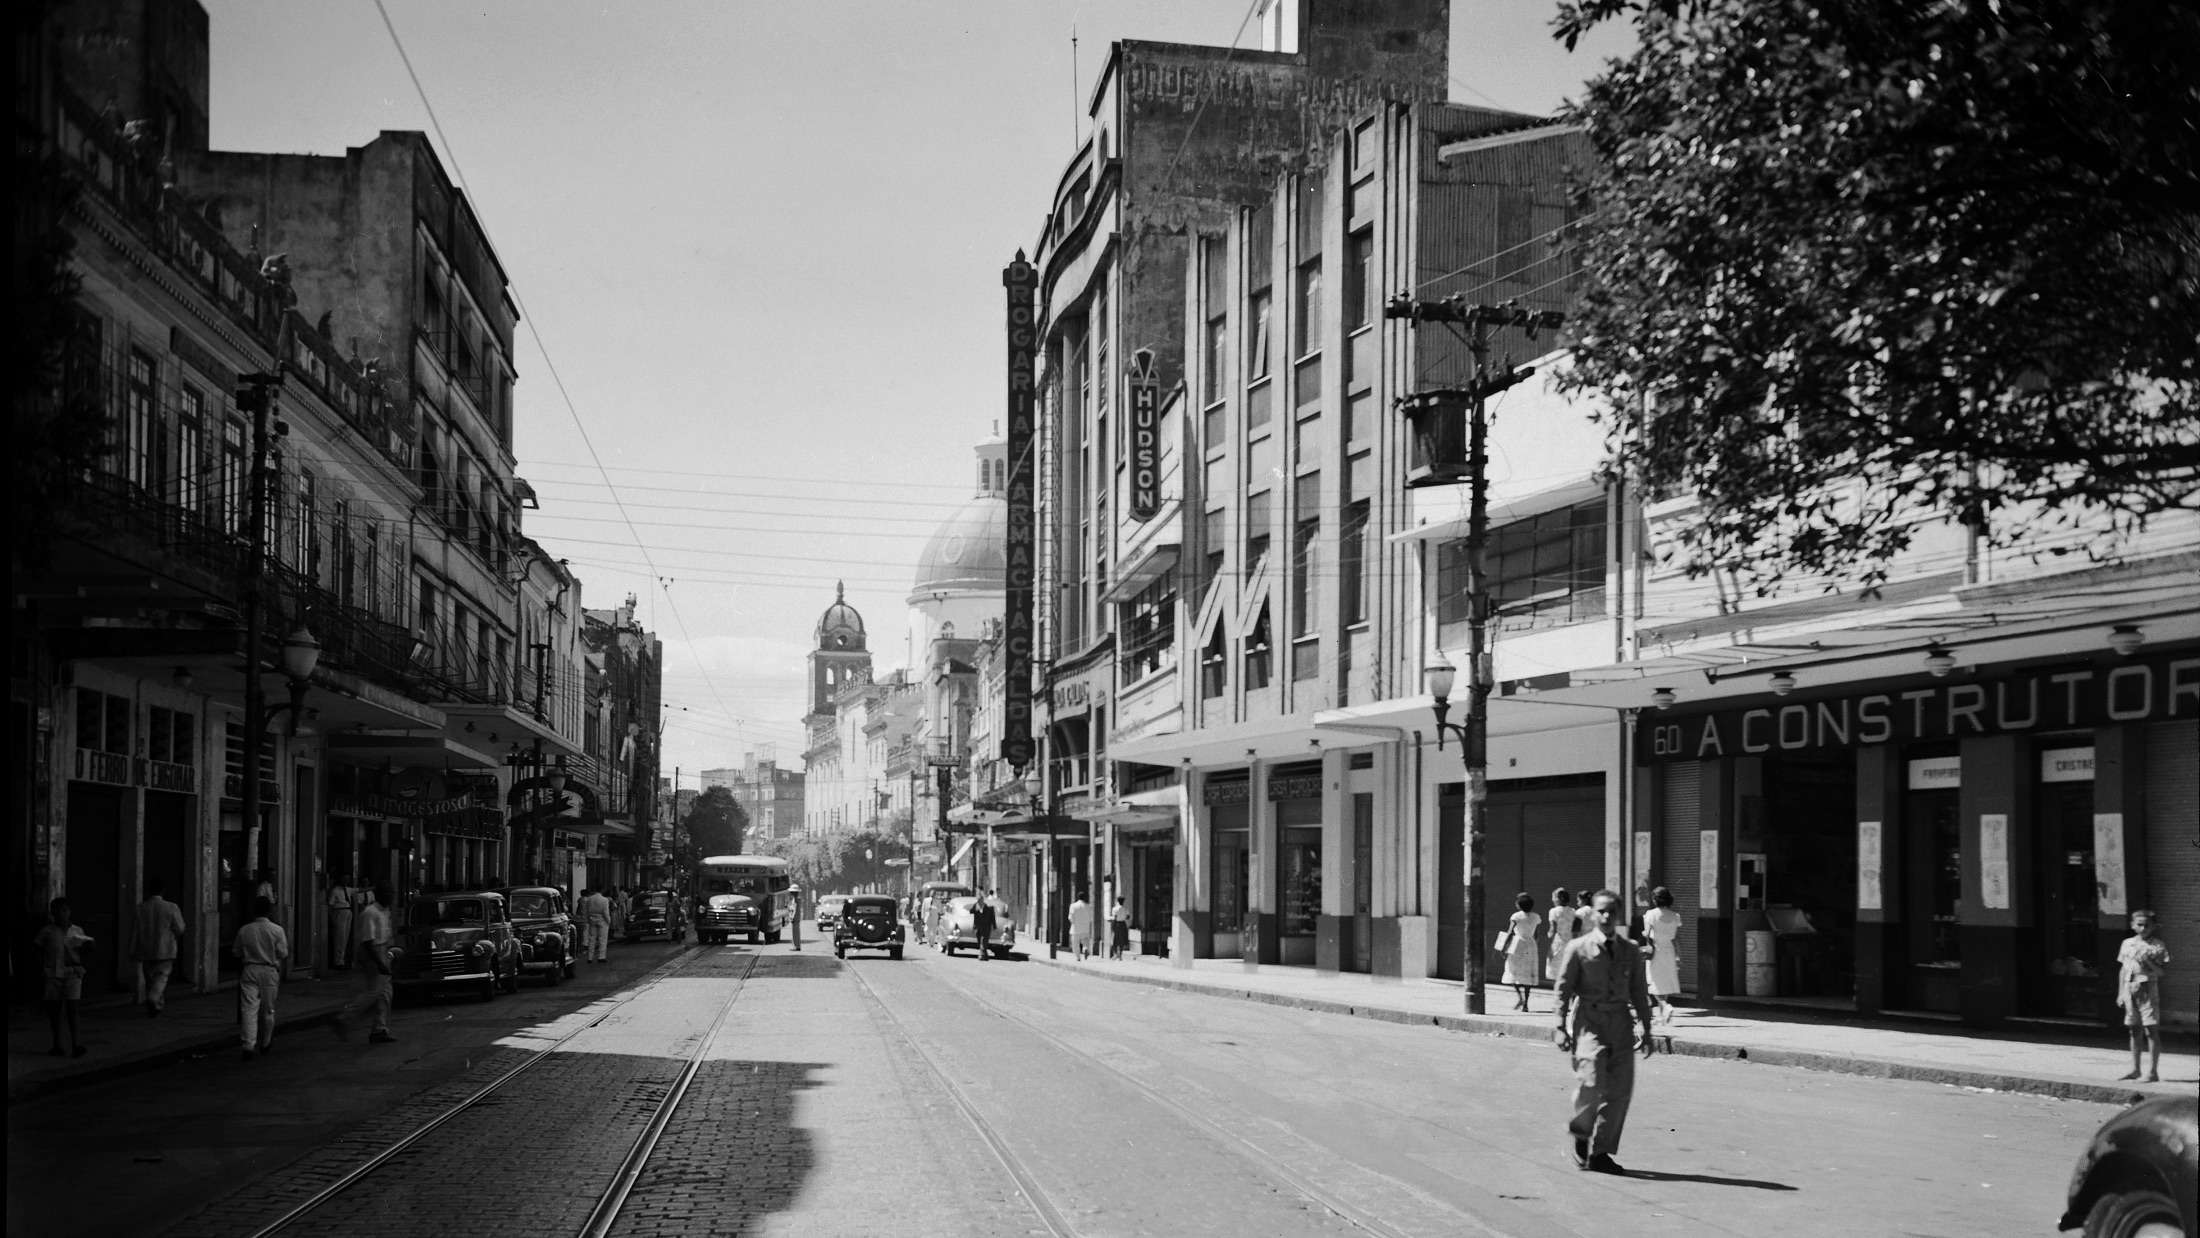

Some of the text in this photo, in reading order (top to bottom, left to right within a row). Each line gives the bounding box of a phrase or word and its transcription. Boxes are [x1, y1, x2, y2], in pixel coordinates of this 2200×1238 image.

[1011, 263, 1031, 434] DROGARIA
[1137, 391, 1153, 509] HUDSON
[1010, 460, 1030, 630] FARMACIA
[1008, 636, 1028, 763] CALDAS
[1653, 725, 1682, 756] 60
[1697, 715, 1724, 758] A
[89, 750, 128, 786] FERRO
